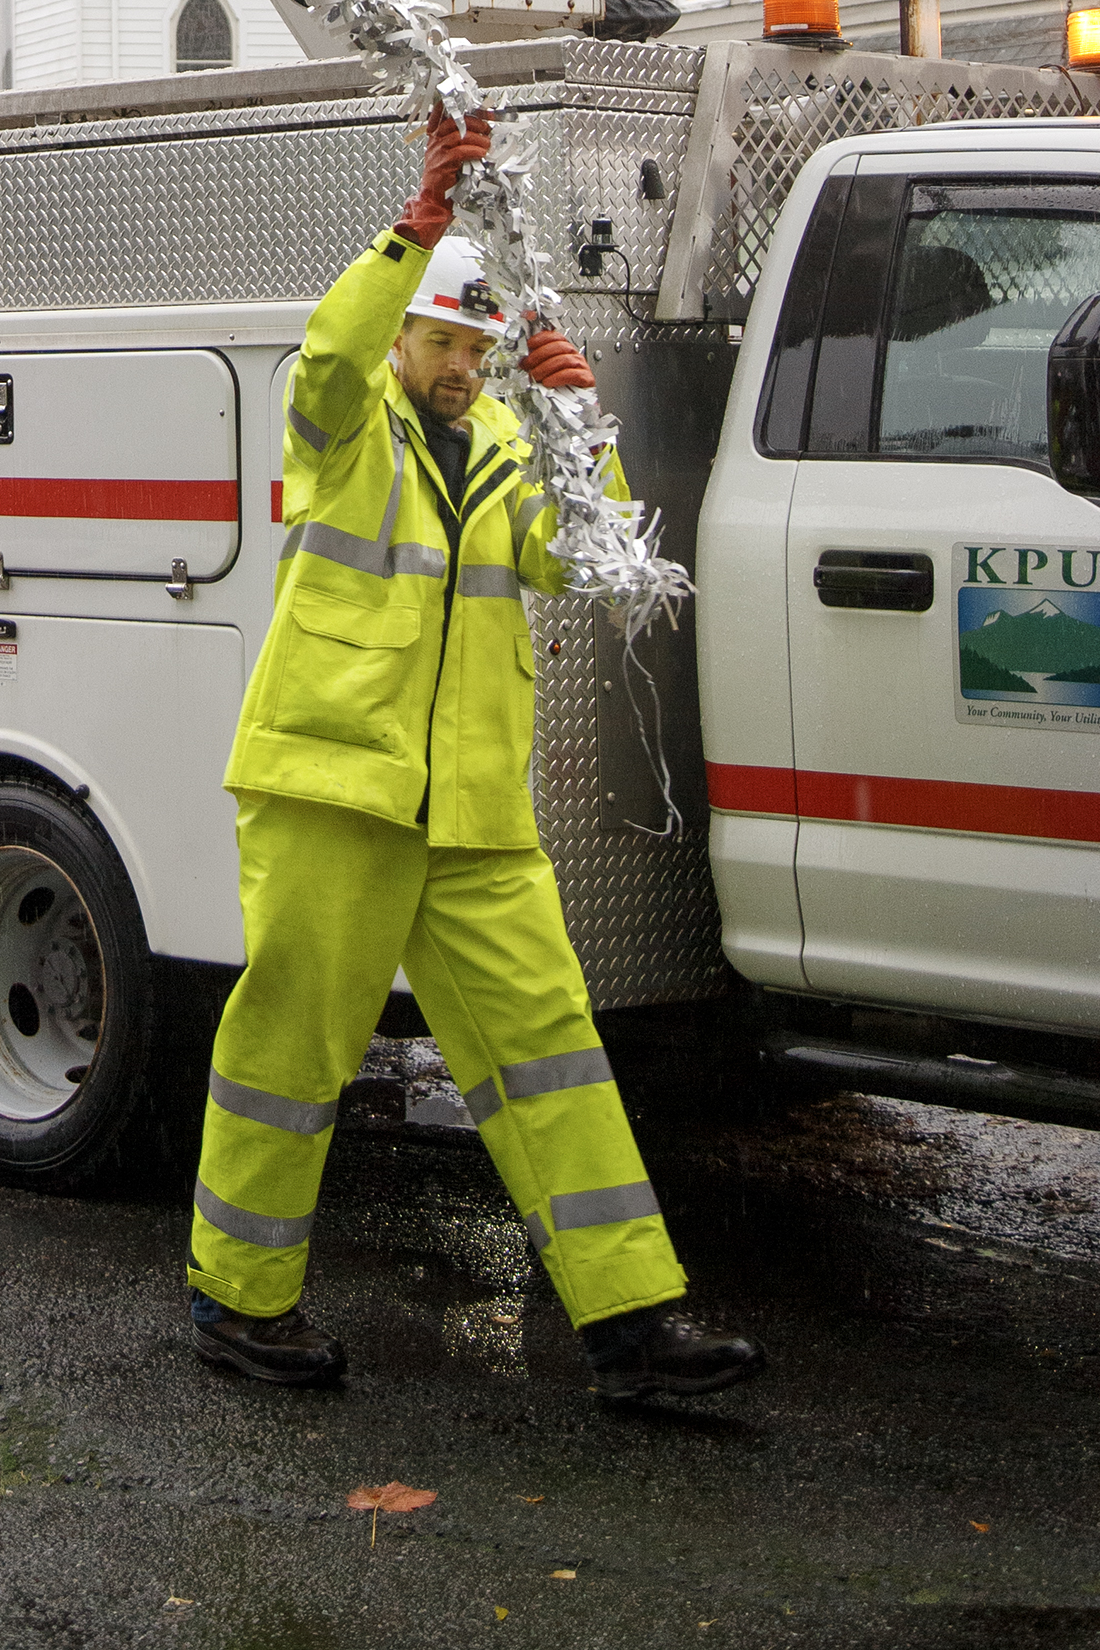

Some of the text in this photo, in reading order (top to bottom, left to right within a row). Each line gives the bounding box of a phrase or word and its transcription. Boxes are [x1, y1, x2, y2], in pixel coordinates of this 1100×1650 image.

[963, 546, 1100, 588] KPU
[967, 705, 1100, 726] Your Community, Your Utilit
